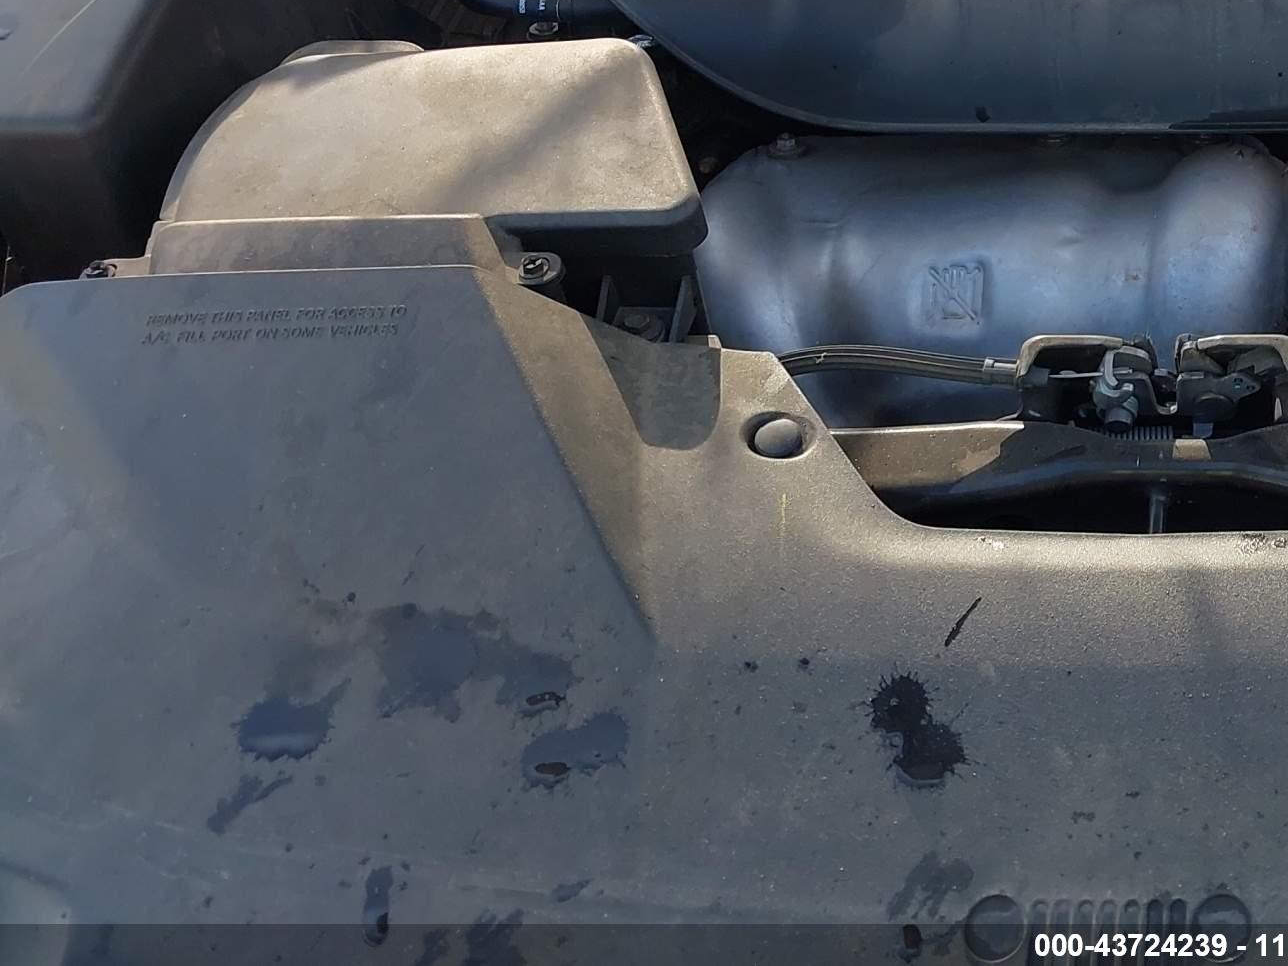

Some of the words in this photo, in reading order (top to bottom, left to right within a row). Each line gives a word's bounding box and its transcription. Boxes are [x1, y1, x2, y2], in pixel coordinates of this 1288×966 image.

[146, 313, 206, 327] REMOVE
[211, 310, 243, 324] THIS
[246, 308, 292, 323] PANEL
[296, 307, 326, 321] FOR
[328, 305, 385, 320] ACCESS
[390, 303, 409, 319] TO
[177, 328, 207, 344] FILL
[211, 327, 251, 343] PORT
[256, 326, 279, 340] ON
[281, 325, 324, 340] SOME
[330, 322, 400, 339] VEHICLES
